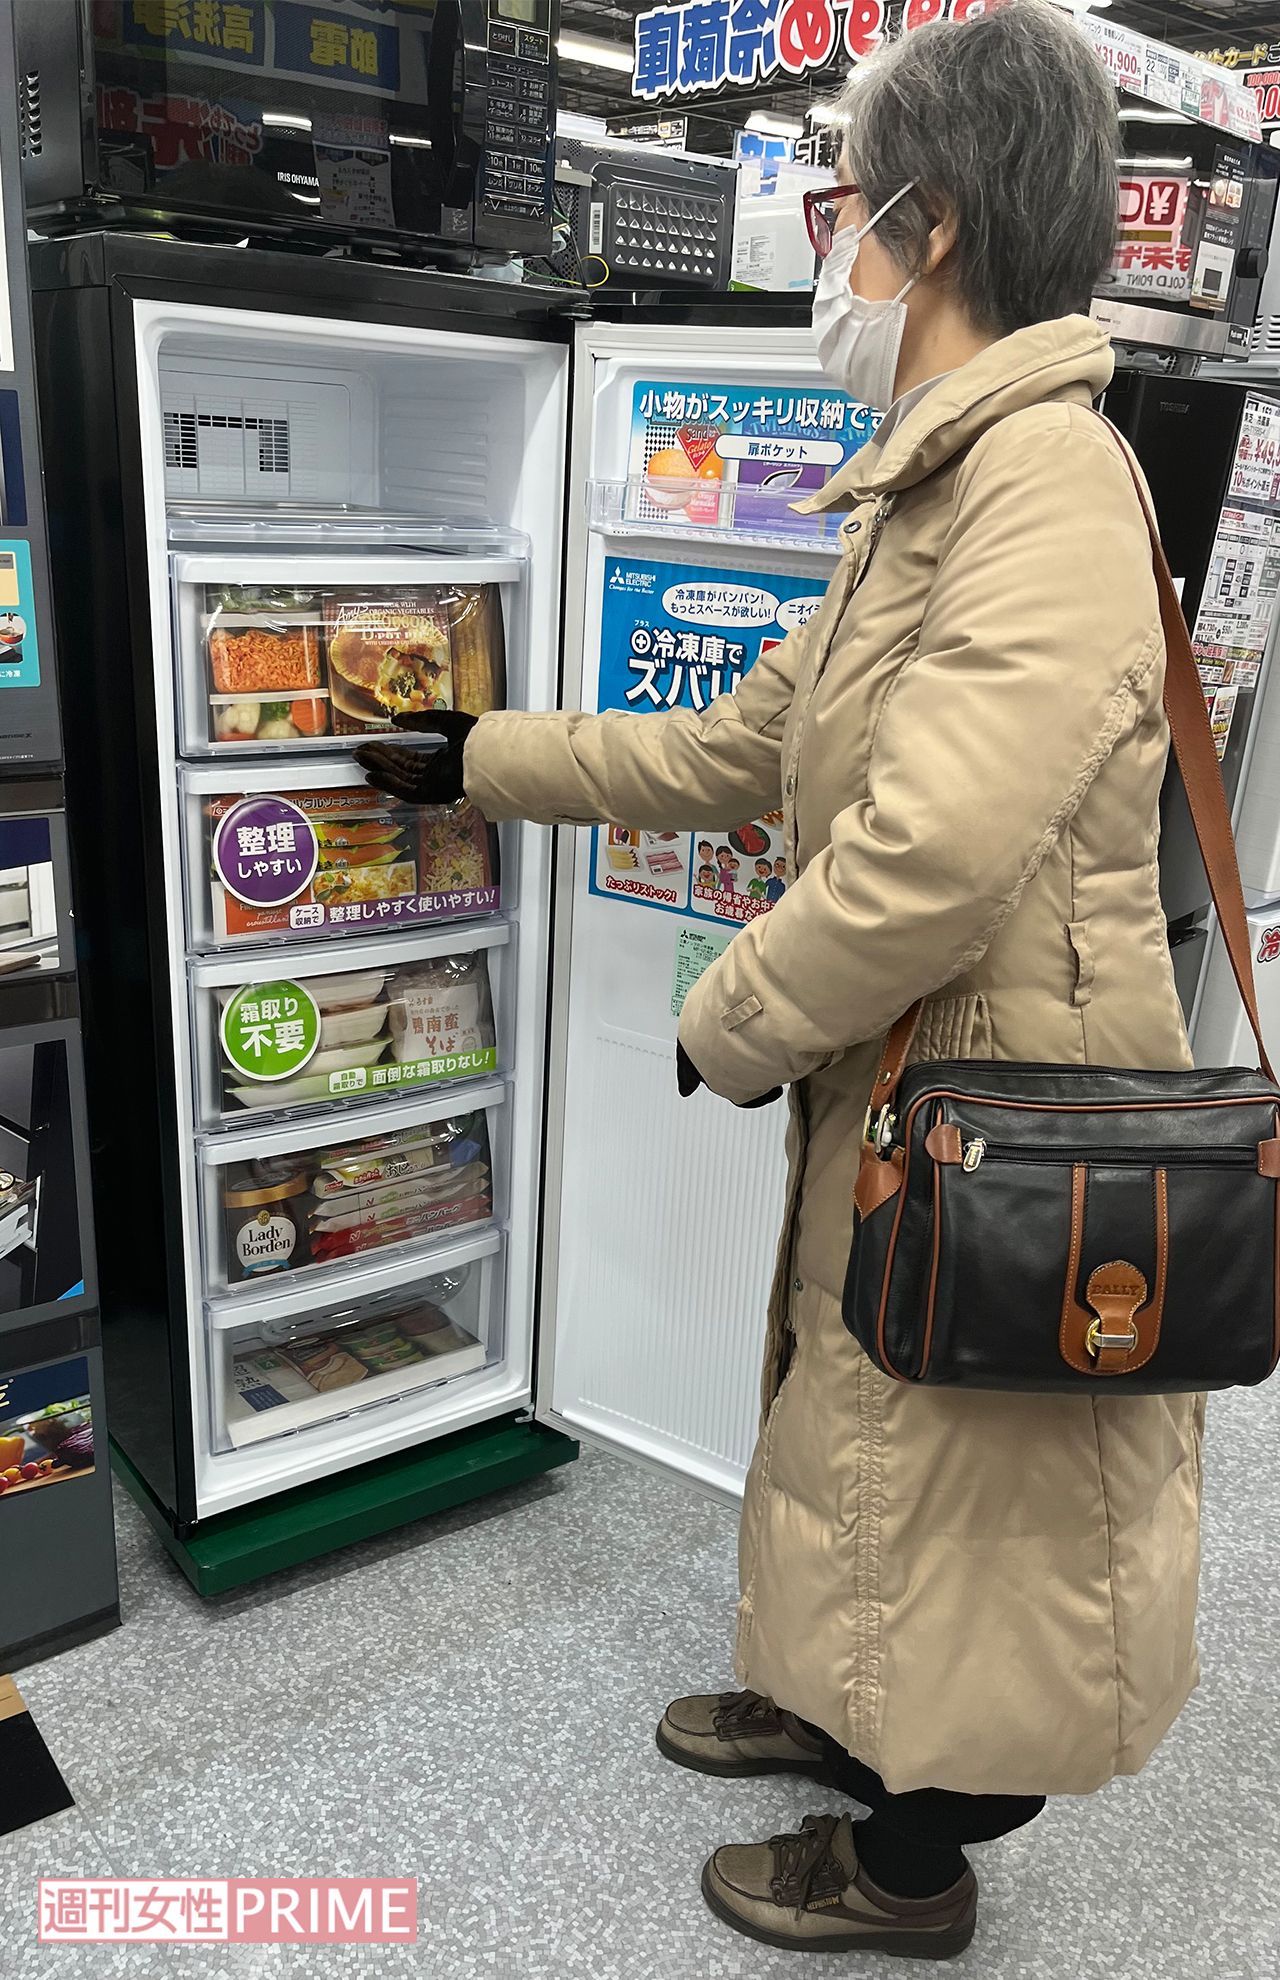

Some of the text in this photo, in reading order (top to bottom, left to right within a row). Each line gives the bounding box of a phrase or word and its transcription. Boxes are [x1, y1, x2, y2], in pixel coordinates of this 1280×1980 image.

[491, 32, 513, 43] とりけし
[524, 34, 544, 44] スタート
[277, 171, 319, 187] IRIS OHYAMA
[508, 181, 523, 190] グリル
[527, 184, 543, 193] オーブン
[748, 442, 809, 459] 扉ポケット
[626, 572, 656, 582] MITSUBISHI
[626, 579, 652, 588] ELECTRIC
[369, 607, 435, 616] ORGANIC VEGETABLES
[670, 602, 771, 619] もっとスペースが欲しい!
[788, 603, 820, 615] ニオイ
[634, 619, 650, 628] プラス
[652, 628, 743, 666] 冷凍庫で
[236, 821, 296, 857] 整理
[237, 858, 302, 880] しやすい
[605, 874, 678, 904] たっぷりストック!
[329, 889, 496, 924] 整理しやすく使いやすい!
[693, 884, 777, 912] 家族の帰省やお中
[295, 906, 319, 915] ケース
[714, 903, 762, 924] お歳暮な
[294, 915, 319, 926] 収納で
[240, 997, 299, 1024] 霜取り
[411, 1013, 459, 1035] 鴨南蛮
[240, 1020, 305, 1057] 不要
[425, 1032, 459, 1055] そば
[372, 1052, 490, 1085] 面倒な霜取りなし!
[333, 1079, 363, 1091] 霜取りで
[248, 1225, 283, 1245] Lady
[242, 1236, 292, 1258] Borden
[1092, 1284, 1140, 1296] BALLY
